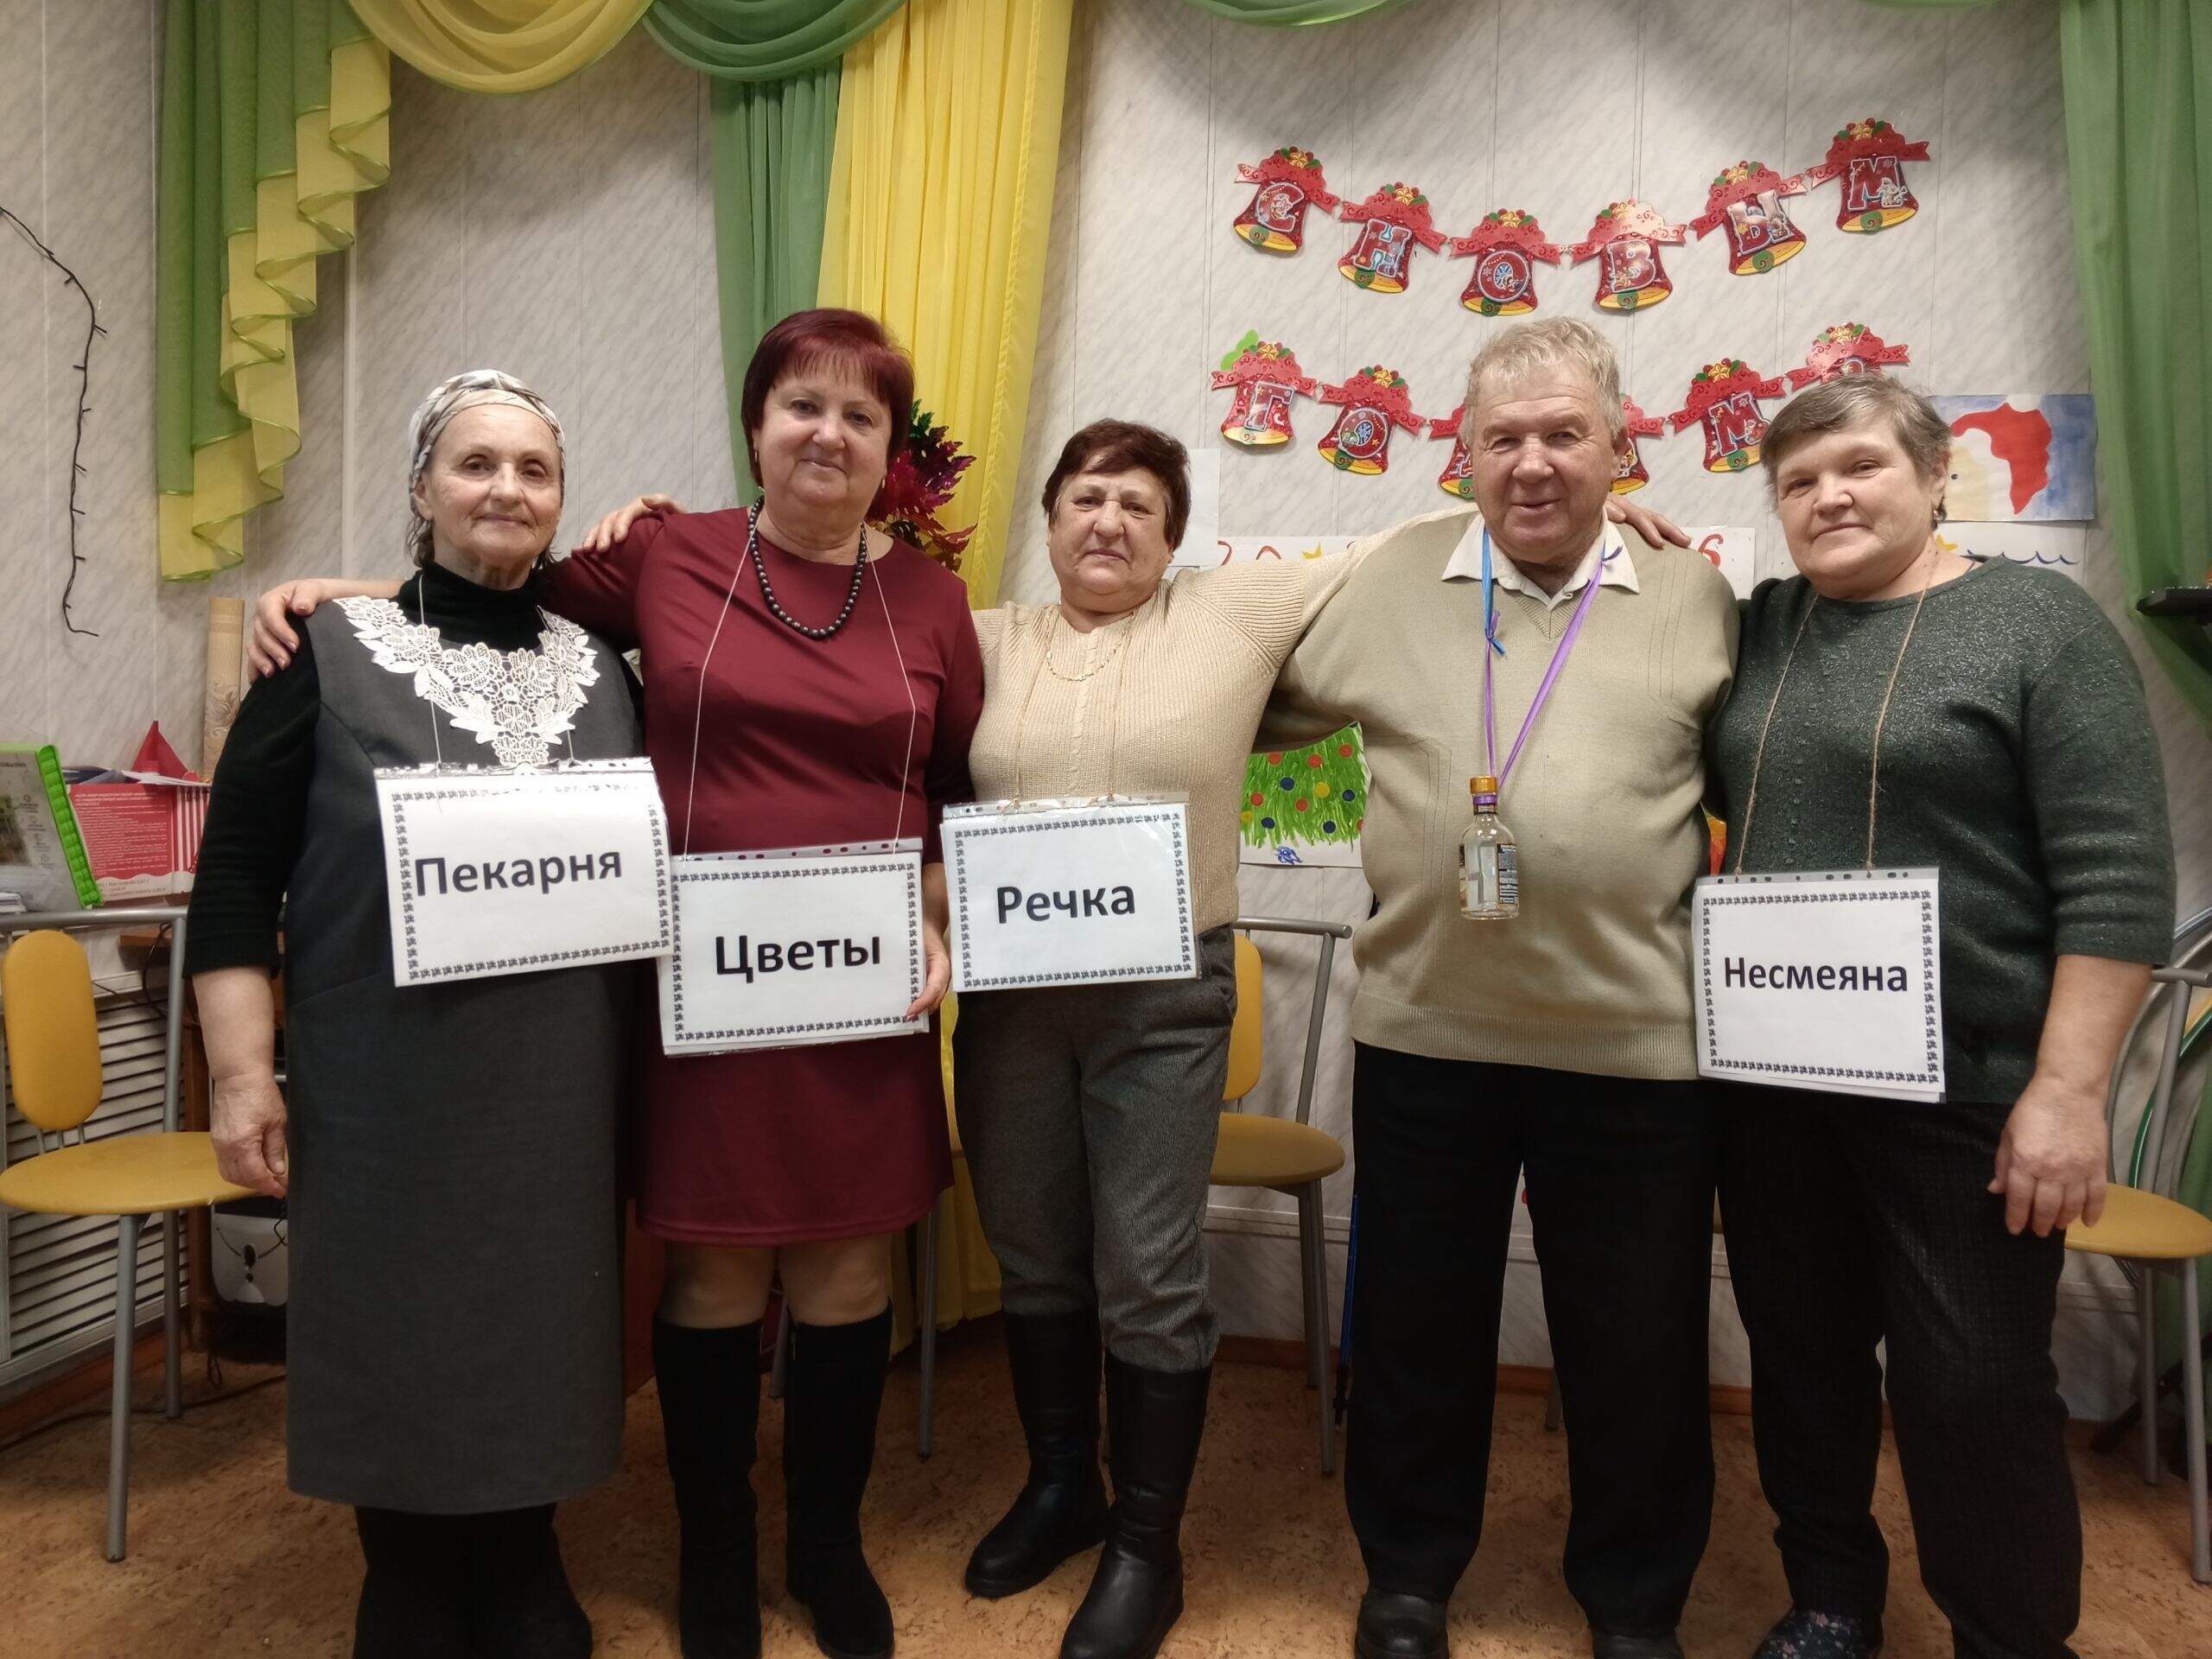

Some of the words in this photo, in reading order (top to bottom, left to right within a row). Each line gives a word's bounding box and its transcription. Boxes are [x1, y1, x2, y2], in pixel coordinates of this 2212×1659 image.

[1255, 181, 1306, 233] С
[1353, 156, 1904, 303] НОВЫМ
[414, 851, 622, 897] Пекарня
[995, 885, 1136, 925] Речка
[715, 934, 881, 984] Цветы
[1724, 957, 1908, 992] Несмеяна
